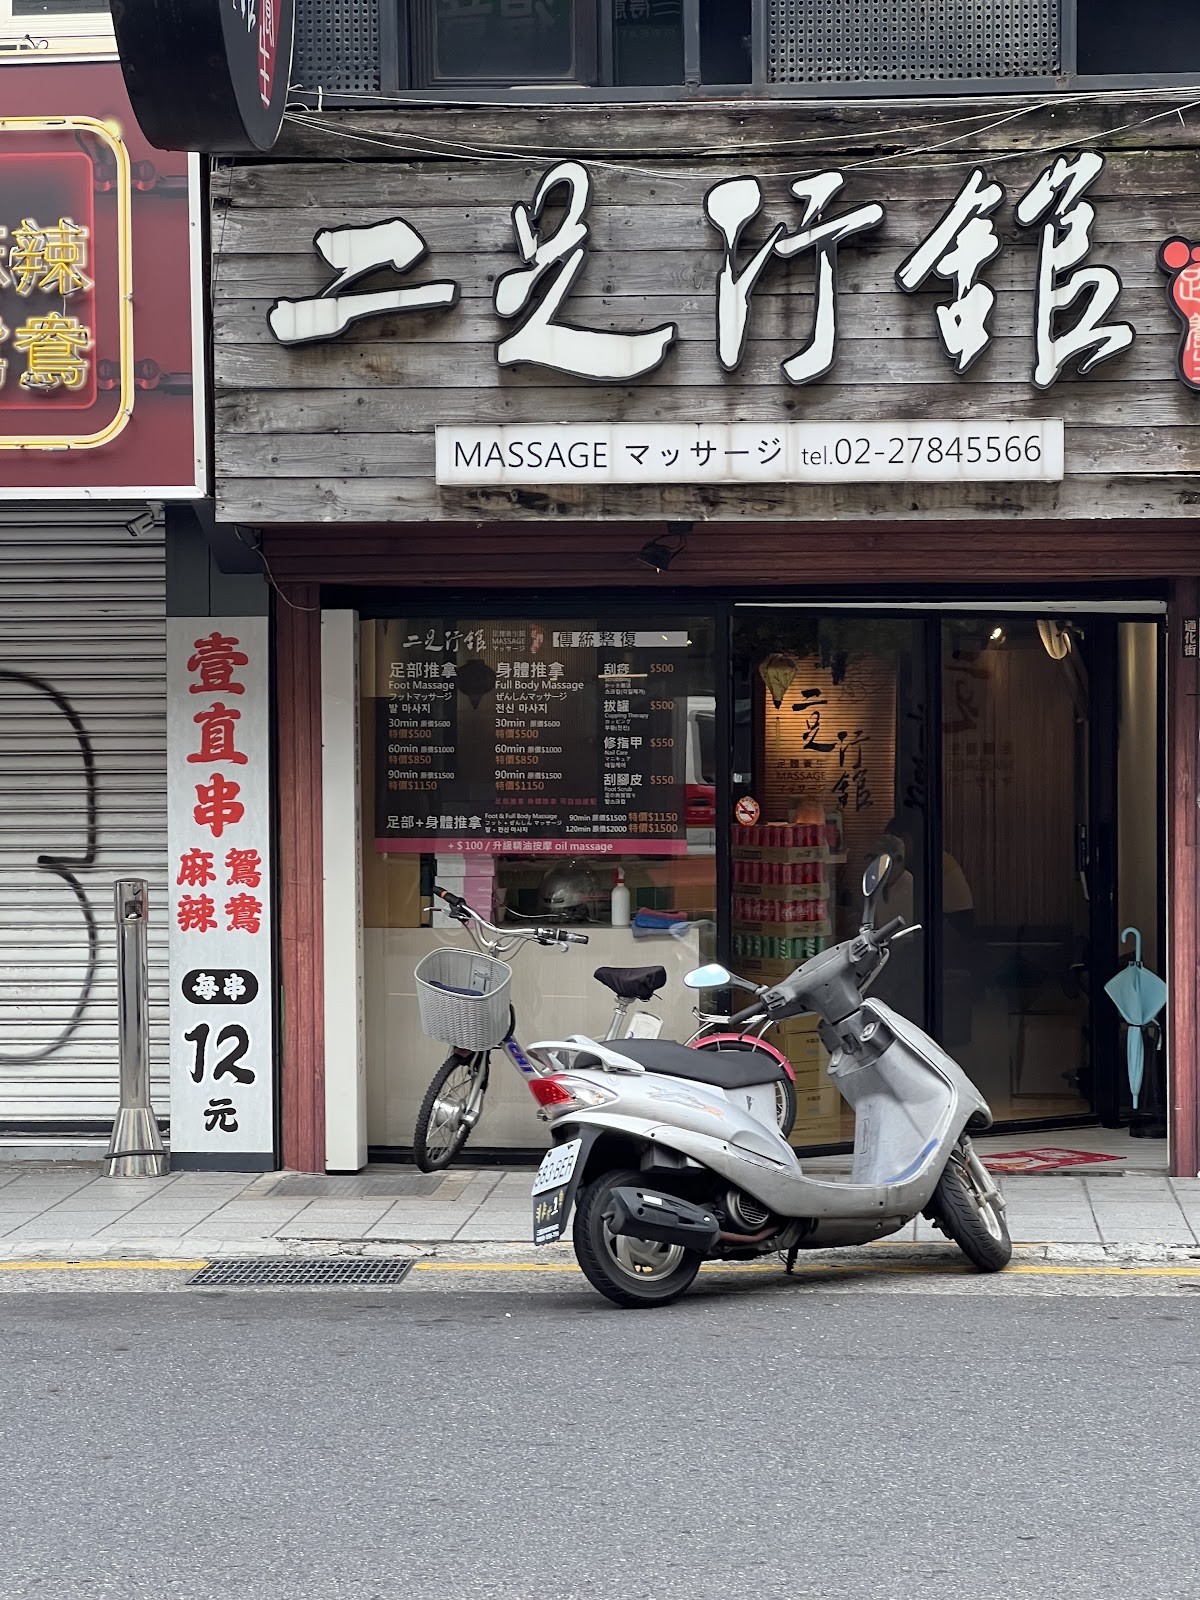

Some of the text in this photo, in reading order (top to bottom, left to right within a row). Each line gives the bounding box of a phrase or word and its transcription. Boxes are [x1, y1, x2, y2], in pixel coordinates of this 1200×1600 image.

[454, 441, 609, 468] MASSAGE
[625, 438, 781, 467] マッサージ
[557, 630, 637, 648] 傳統整復
[1184, 619, 1197, 656] 通化街
[389, 662, 458, 678] 足部推拿
[496, 662, 564, 678] 身體推拿
[650, 664, 674, 673] $500
[388, 680, 455, 692] Foot Massage
[495, 680, 584, 692] Full Body Massage
[389, 692, 452, 701] フットマッサージ
[496, 692, 568, 701] ぜんしんマッサージ
[388, 703, 431, 714] 발 마사지
[496, 703, 548, 714] 전신 마사지
[604, 700, 674, 713] 拔罐 $500
[388, 718, 418, 728] 30min
[495, 718, 526, 728] 30min
[187, 631, 249, 838] 壹直串
[388, 728, 432, 738] 特價$500
[496, 728, 539, 738] 特價$500
[388, 744, 418, 753] 60min
[495, 744, 526, 753] 60min
[604, 736, 674, 750] 修指甲 $550
[388, 754, 432, 764] 特價$850
[496, 754, 539, 764] 特價$850
[388, 770, 418, 779] 90min
[495, 770, 526, 779] 90min
[604, 774, 674, 786] 刮腳皮 $550
[776, 771, 826, 780] MASSAGE
[388, 780, 438, 790] 特價$1150
[496, 780, 545, 790] 特價$1150
[386, 815, 482, 830] 足部+身體推拿
[568, 814, 590, 822] 90min
[628, 812, 678, 822] 特價$1150
[628, 822, 678, 833] 特價$1500
[492, 840, 552, 851] 升級精油按摩
[554, 842, 568, 850] oil
[570, 844, 613, 852] massage
[176, 847, 218, 933] 麻辣
[224, 847, 263, 934] 鴛鴦
[191, 972, 247, 1001] 每串
[184, 1022, 256, 1085] 12
[203, 1098, 239, 1133] 元
